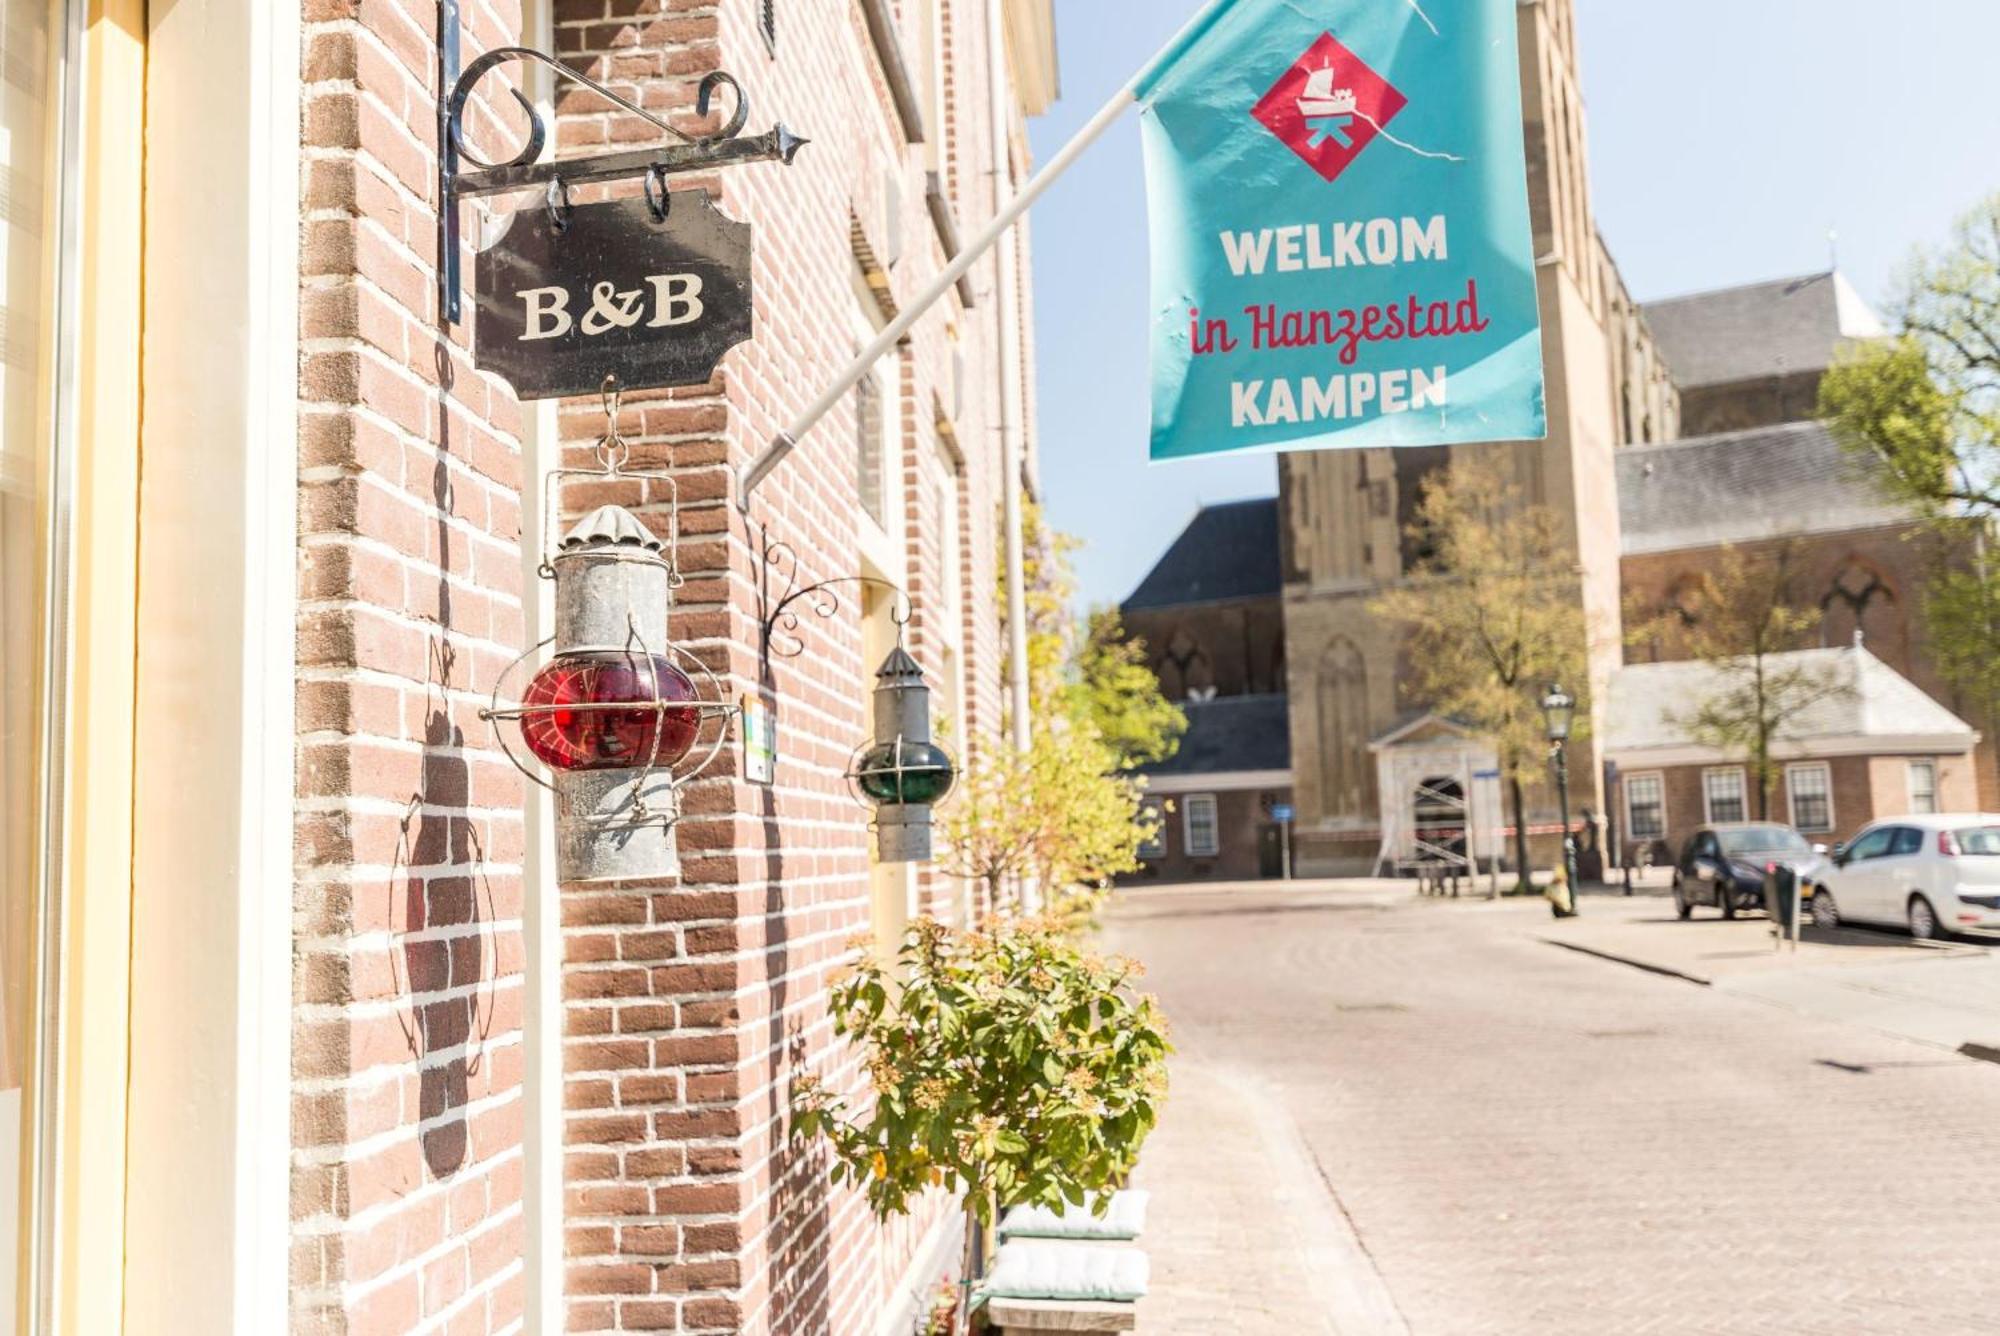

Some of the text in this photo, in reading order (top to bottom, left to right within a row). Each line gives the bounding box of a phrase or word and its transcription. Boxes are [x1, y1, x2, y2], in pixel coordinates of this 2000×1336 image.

[1219, 214, 1448, 277] WELKOM
[516, 273, 704, 341] B&B
[1189, 278, 1491, 364] in Hanzestad
[1230, 365, 1448, 428] KAMPEN
